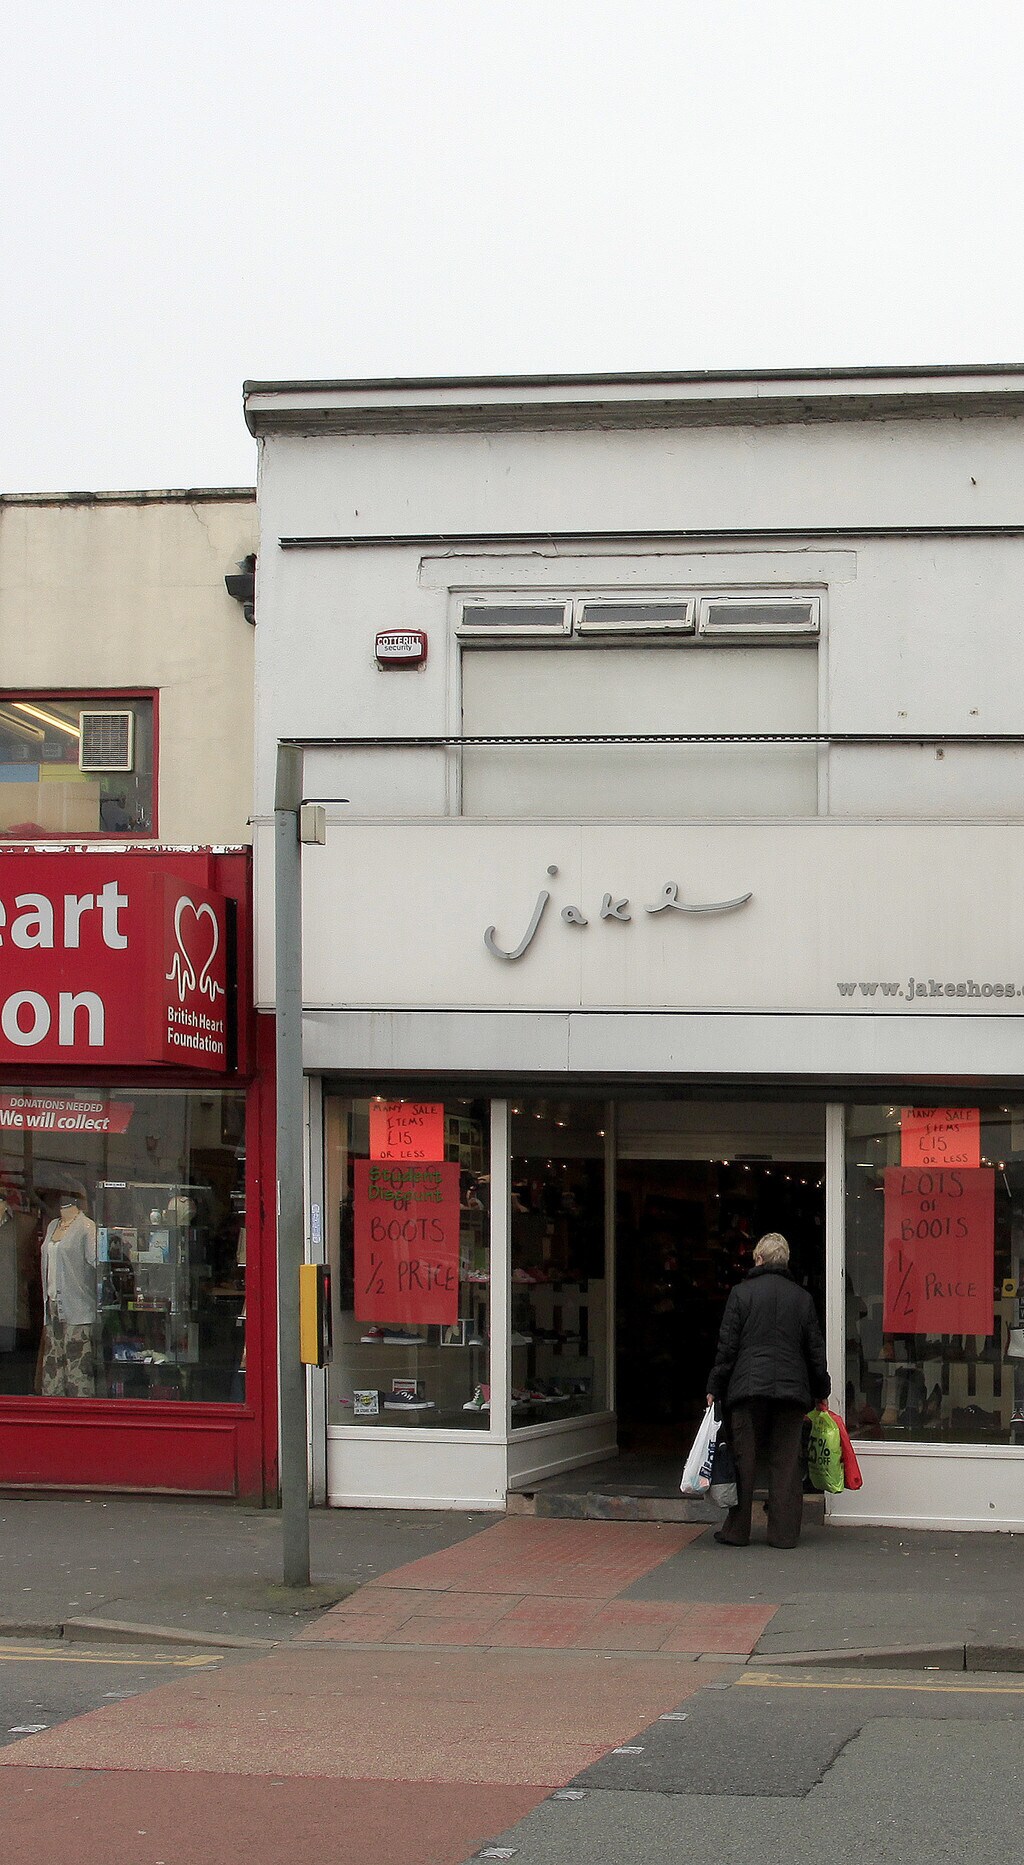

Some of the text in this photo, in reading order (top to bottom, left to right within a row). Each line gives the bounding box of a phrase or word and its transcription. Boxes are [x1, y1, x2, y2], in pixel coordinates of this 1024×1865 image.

[377, 636, 421, 646] COTTERILL
[0, 880, 129, 950] art
[484, 864, 753, 960] jake
[1, 990, 105, 1047] on
[167, 1005, 224, 1033] British Heart
[167, 1026, 224, 1054] Foundation
[10, 1097, 103, 1113] DONATIONS NEEDED
[372, 1104, 438, 1116] MANY SALE
[907, 1108, 973, 1121] MANY SALE
[0, 1109, 110, 1131] We will collect
[386, 1117, 425, 1129] ITEMS
[925, 1123, 960, 1135] ITEMS
[380, 1150, 425, 1159] OR LESS
[923, 1153, 969, 1164] OR LESS
[368, 1166, 444, 1184] Student
[901, 1171, 964, 1197] LOTS
[368, 1184, 445, 1204] Discount
[371, 1216, 445, 1243] BOOTS
[901, 1216, 969, 1242] BOOTS
[397, 1260, 456, 1293] PRICE
[925, 1272, 978, 1300] PRICE
